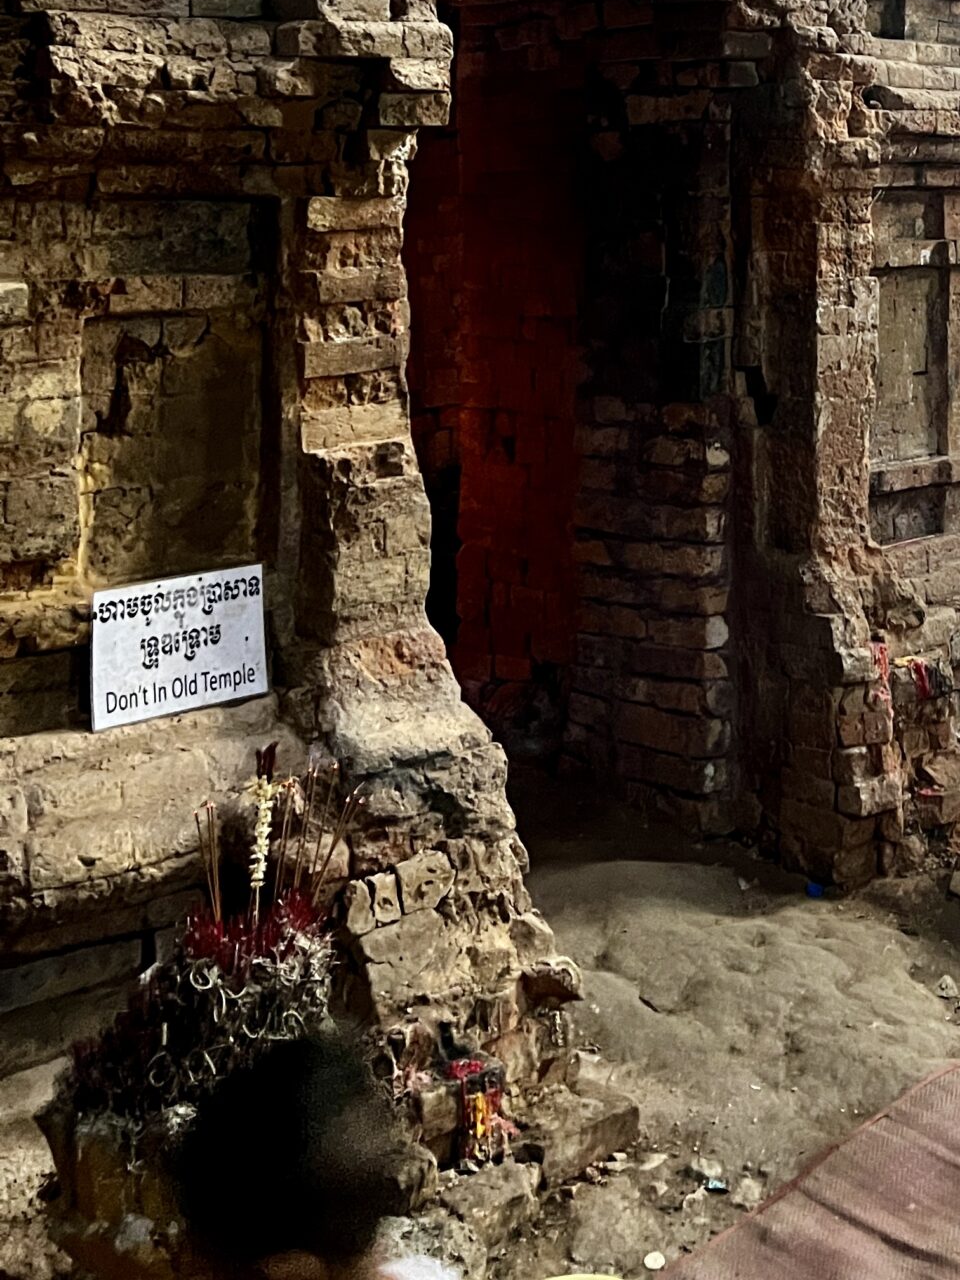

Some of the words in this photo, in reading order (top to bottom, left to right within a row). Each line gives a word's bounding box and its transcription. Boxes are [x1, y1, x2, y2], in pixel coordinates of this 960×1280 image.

[105, 685, 149, 714] Don't
[153, 682, 167, 703] In
[171, 673, 198, 698] Old
[201, 663, 256, 692] Temple
